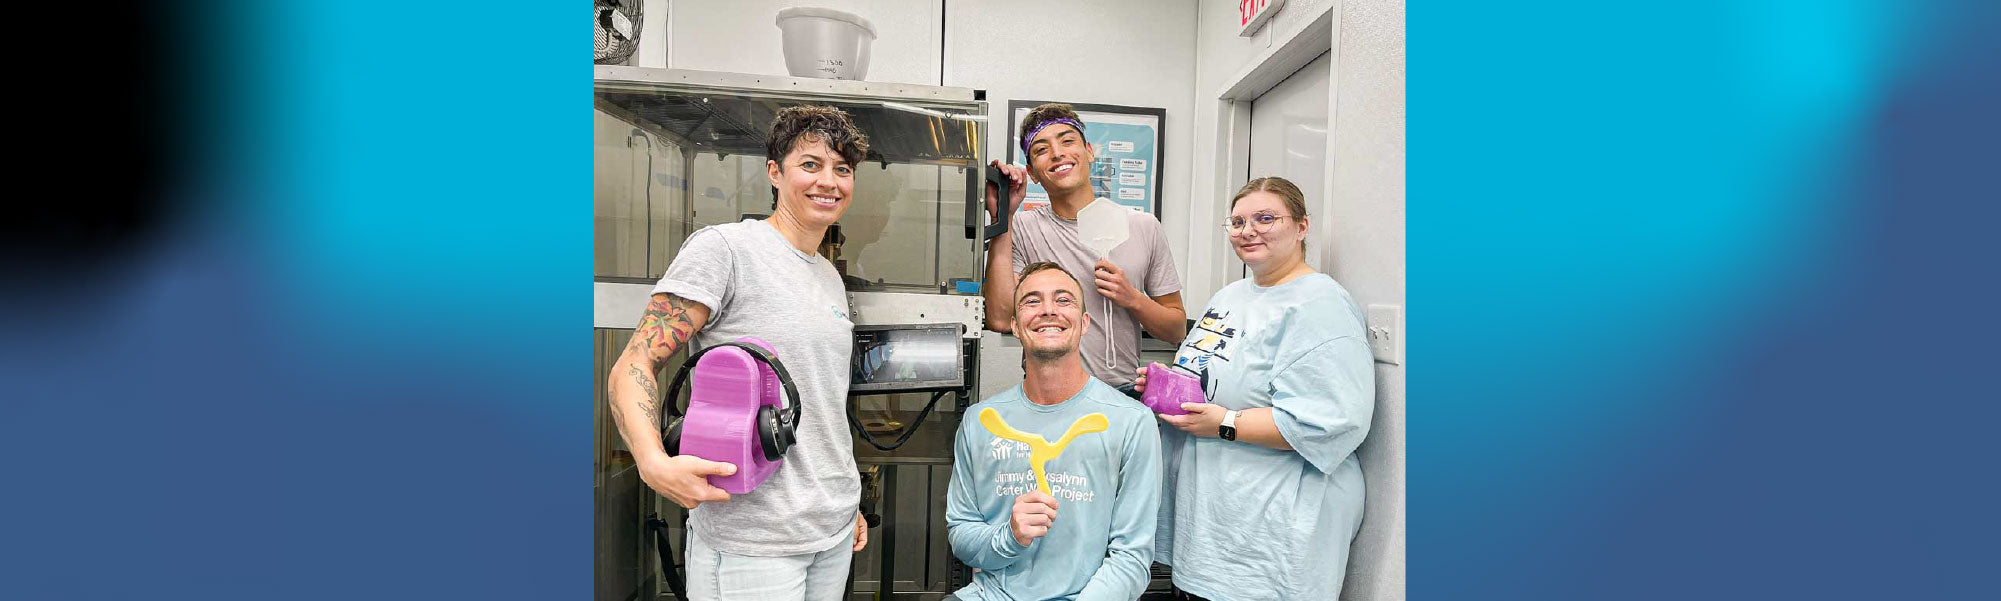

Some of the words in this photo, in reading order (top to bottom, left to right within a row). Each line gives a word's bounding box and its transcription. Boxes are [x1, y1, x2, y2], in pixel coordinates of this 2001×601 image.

[1241, 0, 1265, 26] EX
[996, 471, 1024, 484] Jimmy
[1026, 468, 1035, 481] &
[1046, 471, 1088, 487] salynn
[996, 484, 1024, 497] Carter
[1051, 484, 1094, 502] Project
